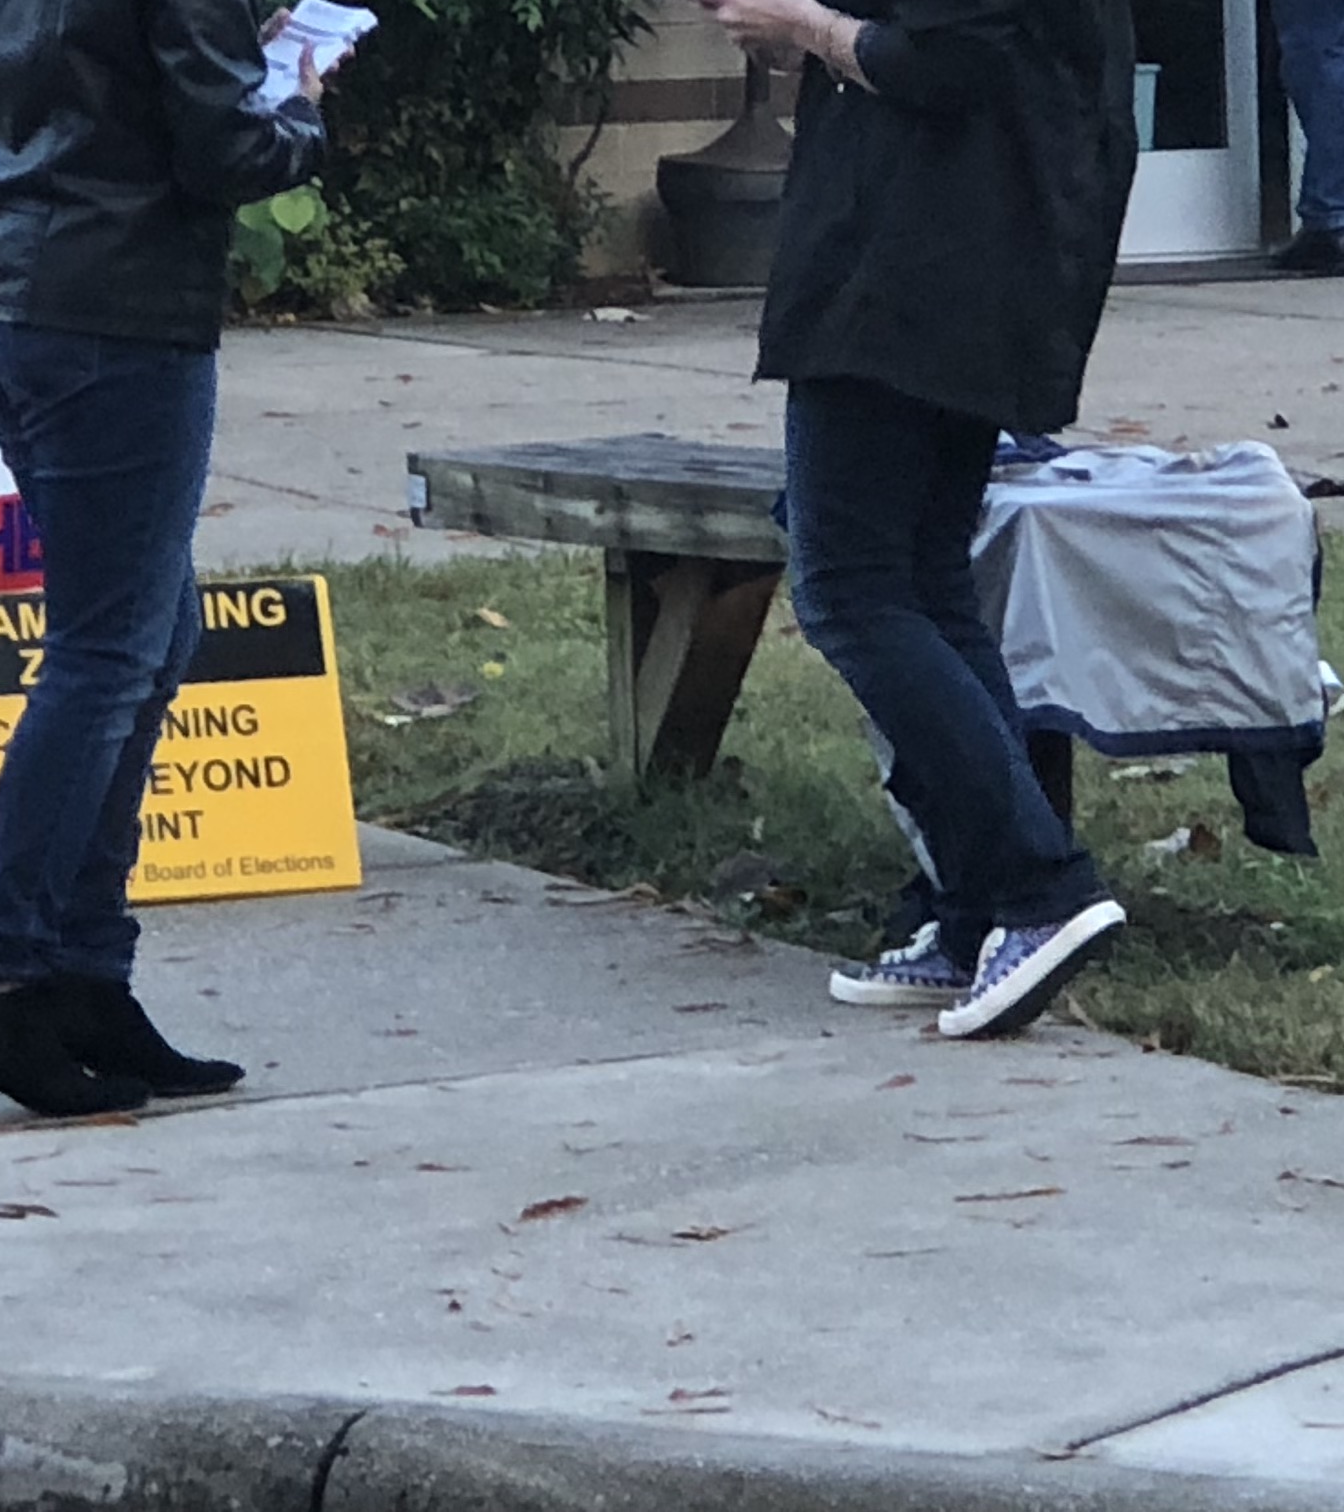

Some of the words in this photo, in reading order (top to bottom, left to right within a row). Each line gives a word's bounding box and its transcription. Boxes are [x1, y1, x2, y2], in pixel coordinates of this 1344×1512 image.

[149, 755, 292, 795] EYOND
[145, 810, 204, 842] INT
[144, 861, 205, 882] Board
[213, 858, 233, 877] of
[240, 854, 335, 876] Elections
